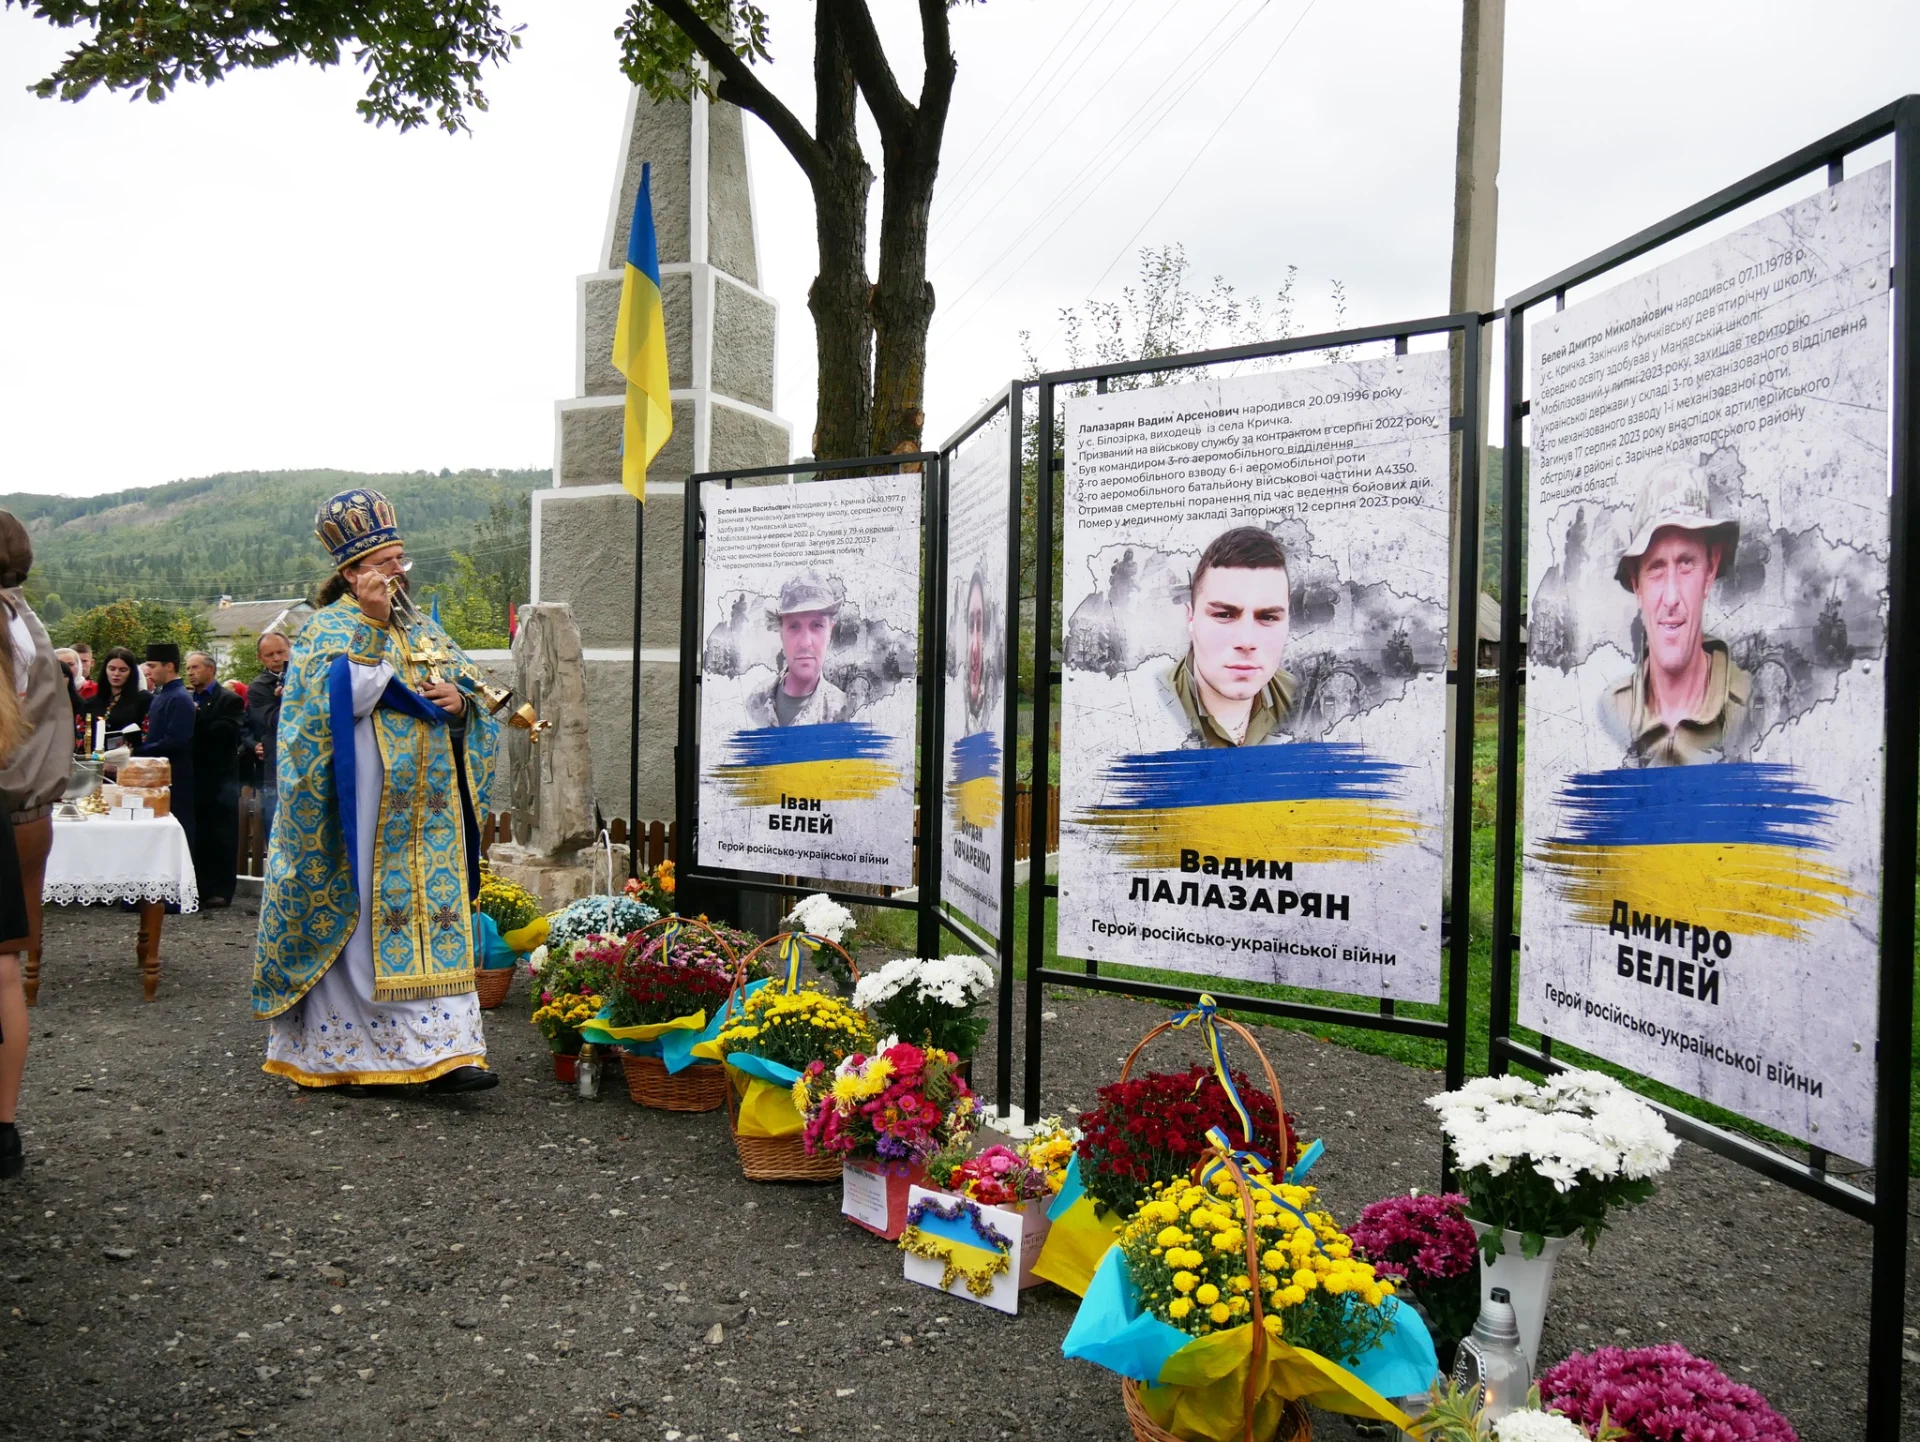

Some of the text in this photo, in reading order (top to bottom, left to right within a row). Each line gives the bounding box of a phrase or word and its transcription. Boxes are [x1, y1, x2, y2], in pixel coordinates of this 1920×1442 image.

[1540, 373, 1545, 385] у
[1589, 340, 1628, 363] Закінчив
[1631, 315, 1693, 348] Кричківську
[1695, 285, 1770, 324] дев'ятирічну
[1773, 268, 1817, 293] школу,
[1541, 249, 1806, 365] Белей Дмитро Миколайович народився 07.11.1978 р.
[1541, 307, 1763, 399] середню освіту здобував у Манявській школі.
[1541, 385, 1602, 416] Мобілізований
[1611, 372, 1638, 392] липні
[1640, 364, 1662, 382] 2023
[1693, 339, 1742, 364] захищав
[1745, 315, 1810, 346] територію
[1540, 318, 1867, 436] української держави у складі 3-го механізованого відділення
[1078, 389, 1402, 433] Лалазарян Вадим Арсенович народився 20.09.1996 року
[1540, 377, 1830, 467] Загинув 17 серпня 2023 року внаслідок артилерійського
[1558, 417, 1625, 445] механізованого
[1628, 406, 1661, 424] взводу
[1676, 374, 1755, 409] механізованої
[1759, 366, 1791, 389] роти.
[1079, 446, 1133, 462] Призваний
[1150, 441, 1198, 453] військову
[1201, 435, 1239, 449] службу
[1242, 435, 1253, 443] за
[1256, 428, 1321, 442] контрактом
[1333, 420, 1372, 435] серпні
[1375, 417, 1403, 429] 2022
[1406, 416, 1435, 429] року
[1097, 433, 1147, 444] Білозірка,
[1150, 426, 1201, 438] виходець
[1207, 423, 1215, 432] із
[1218, 421, 1243, 431] села
[1247, 416, 1292, 429] Кричка.
[1540, 468, 1575, 485] обстрілу
[1583, 455, 1613, 477] районі
[1615, 456, 1622, 465] с.
[1625, 445, 1663, 463] Зарічне
[1665, 420, 1755, 454] Краматорського
[1759, 407, 1805, 432] району
[1078, 479, 1098, 487] 3-го
[1100, 471, 1185, 487] аеромобільного
[1188, 467, 1226, 477] взводу
[1245, 455, 1332, 473] аеромобільної
[1336, 454, 1365, 466] роти
[1079, 440, 1353, 476] Був командиром 3-го аеромобільного відділення
[1078, 463, 1417, 501] 2-го аеромобільного батальйону військової частини А4350.
[1078, 477, 1433, 516] Отримав смертельні поранення під час ведення бойових дій.
[1540, 482, 1582, 503] Донецької
[1078, 495, 1424, 529] Помер у медичному закладі Запоріжжя 12 серпня 2023 року.
[769, 814, 833, 834] БЕЛЕЙ
[781, 793, 821, 812] Іван
[718, 841, 889, 865] Герой російсько-української війни
[954, 838, 991, 874] ОВЧАРЕНКО
[1180, 849, 1293, 881] Вадим
[1129, 877, 1349, 920] ЛАЛАЗАРЯН
[1092, 919, 1396, 965] Герой російсько-української війни
[1609, 900, 1732, 960] Дмитро
[1617, 944, 1719, 1005] БЕЛЕЙ
[1545, 983, 1823, 1098] Герой російсько-української війни
